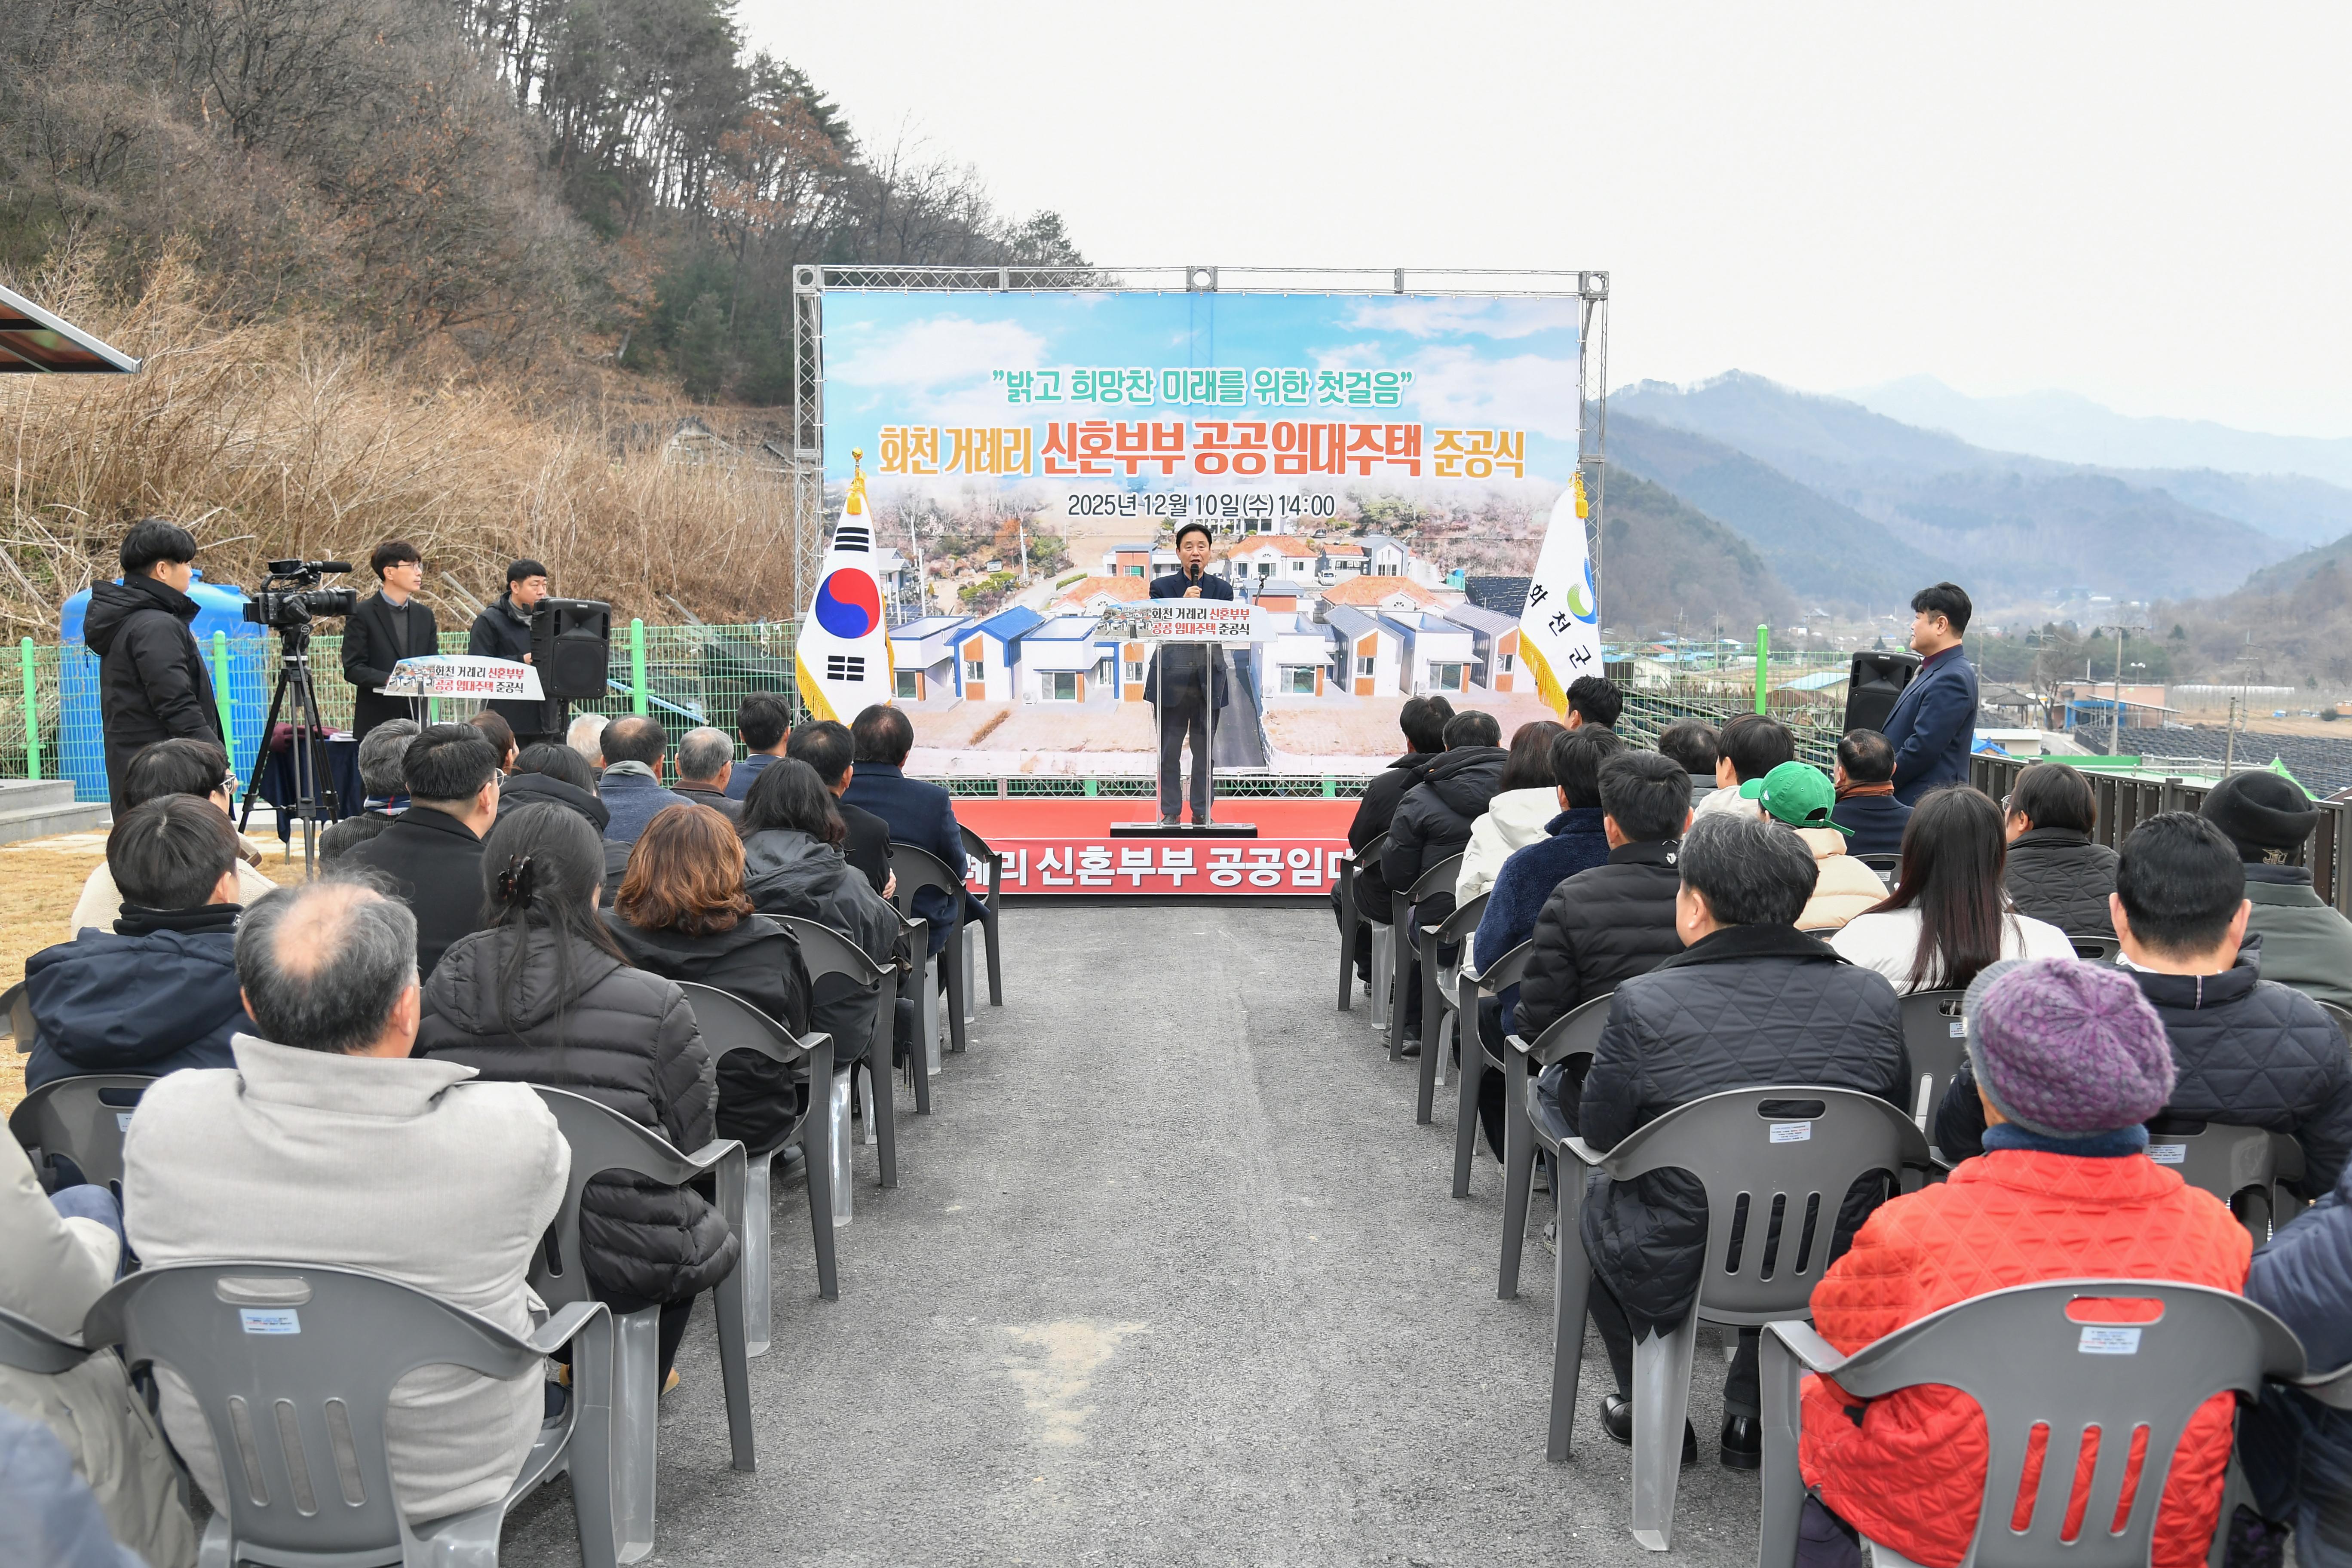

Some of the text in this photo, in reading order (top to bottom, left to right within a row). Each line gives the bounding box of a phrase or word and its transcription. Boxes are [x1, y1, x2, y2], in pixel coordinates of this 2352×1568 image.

[1071, 370, 1154, 402] 희망찬
[1163, 370, 1245, 402] 미래를
[1254, 371, 1309, 402] 위한
[880, 421, 1524, 478] 화천 거례리 신혼부부 공공임대주택 준공식
[1068, 494, 1136, 516] 2025년
[1144, 494, 1187, 517] 12월
[1152, 608, 1173, 620] 화천
[1175, 608, 1207, 620] 거례리
[1209, 608, 1250, 620] 신혼부부
[1152, 622, 1249, 635] 공공 임대주택 준공식
[435, 665, 524, 679] 화천 거례리 신혼부부
[435, 679, 523, 693] 공공 임대주택 준공식
[1035, 846, 1197, 887] 신혼부부
